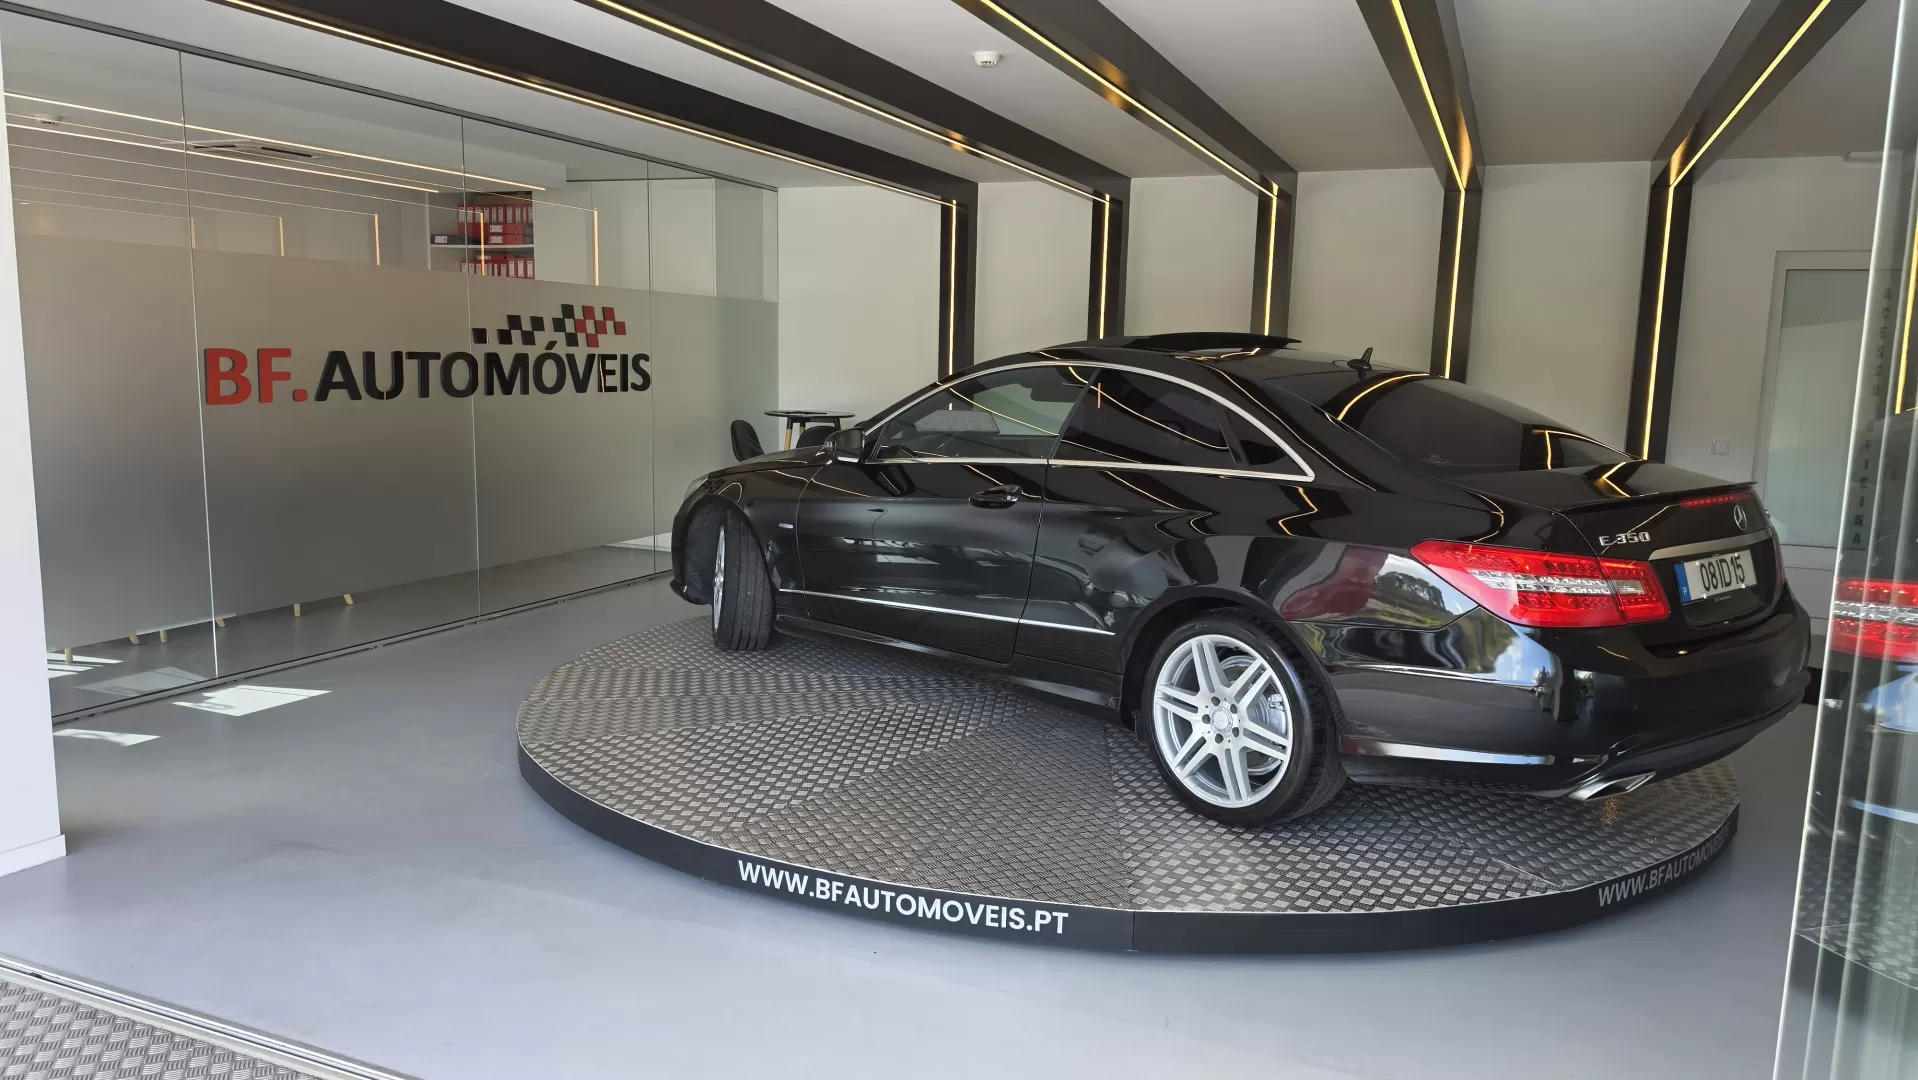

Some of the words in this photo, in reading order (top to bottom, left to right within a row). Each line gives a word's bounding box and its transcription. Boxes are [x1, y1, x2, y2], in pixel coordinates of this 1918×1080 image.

[203, 340, 652, 405] BF.AUTOMÓVEIS
[1599, 535, 1613, 547] E
[1616, 531, 1651, 545] 350
[737, 859, 1069, 935] WWW.BFAUTOMOVEIS.PT
